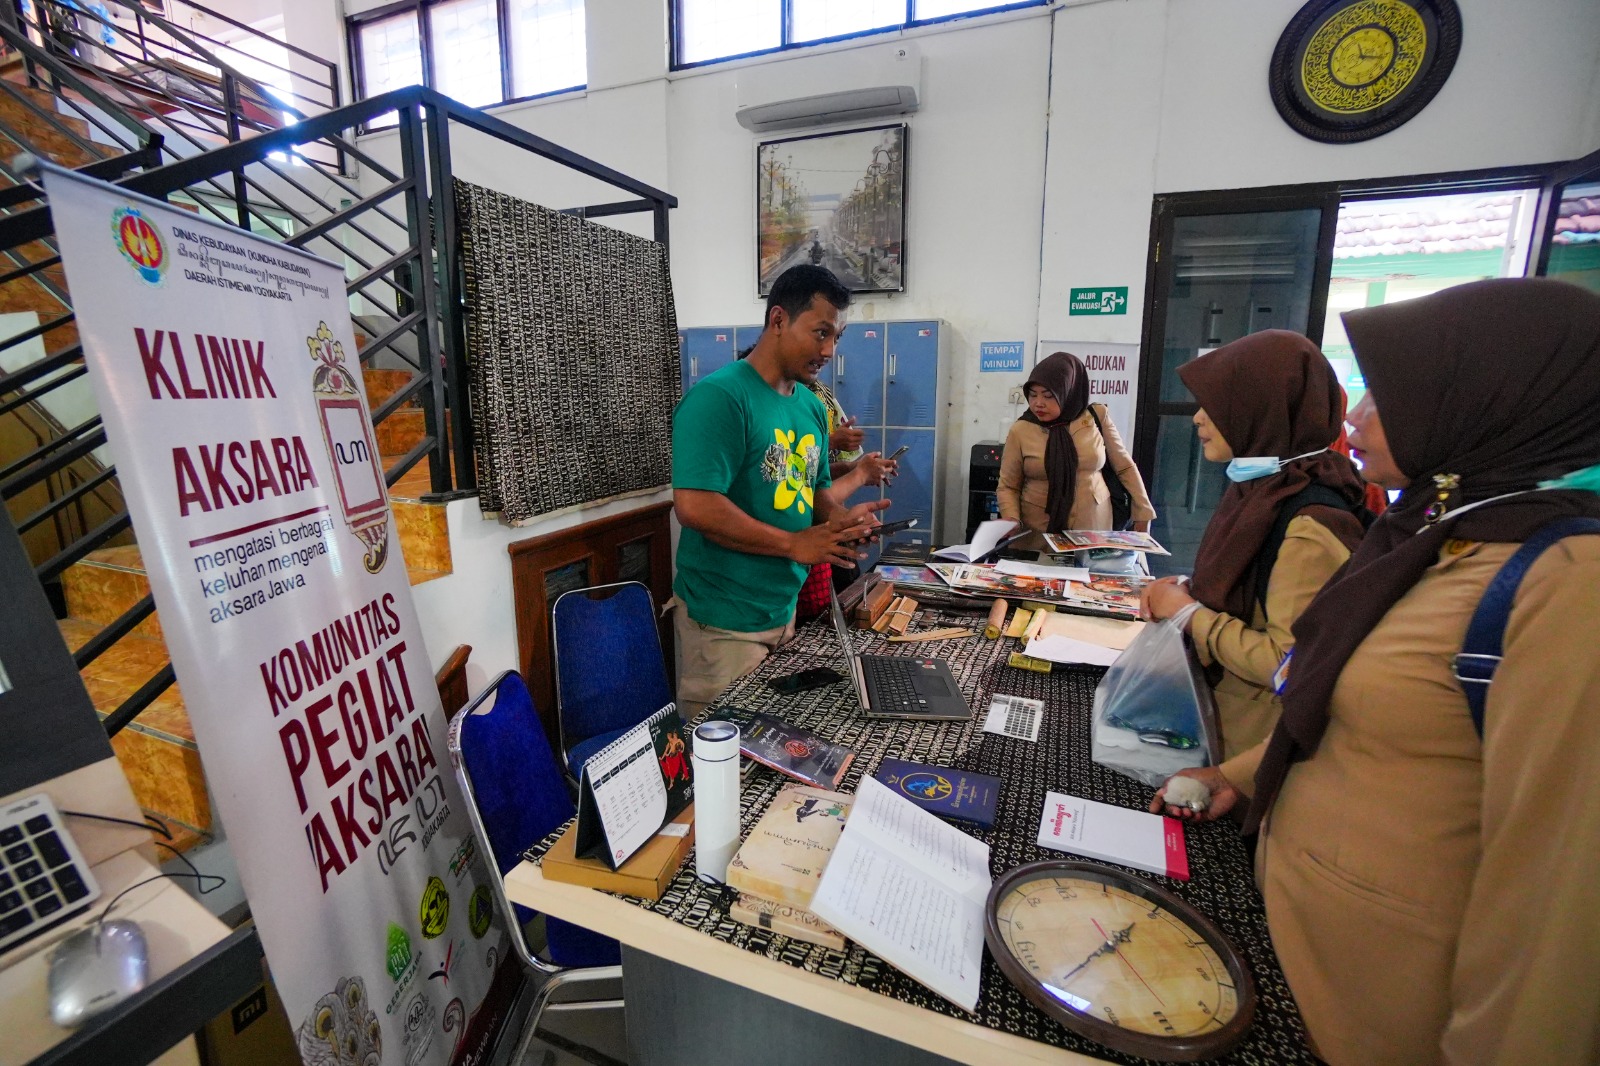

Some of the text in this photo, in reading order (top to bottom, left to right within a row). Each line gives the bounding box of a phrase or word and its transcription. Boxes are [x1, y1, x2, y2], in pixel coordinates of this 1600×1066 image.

[172, 226, 199, 244] DINAS
[199, 234, 247, 258] KEBUDAYAAN
[184, 268, 293, 301] DAERAH ISTIMEWA YOGYAKARTA
[1077, 292, 1096, 300] JALUR
[1071, 302, 1100, 310] EVAKUASI
[134, 327, 277, 400] KLINIK
[983, 346, 1020, 355] TEMPAT
[984, 360, 1019, 368] MINUM
[1089, 379, 1129, 395] ELUHAN
[172, 435, 320, 517] AKSARA
[194, 514, 334, 573] mengatasi berbagai
[200, 537, 329, 598] keluhan mengenai
[209, 573, 306, 624] aksara Jawa
[260, 592, 401, 718] KOMUNITAS
[278, 640, 415, 815] PEGIAT
